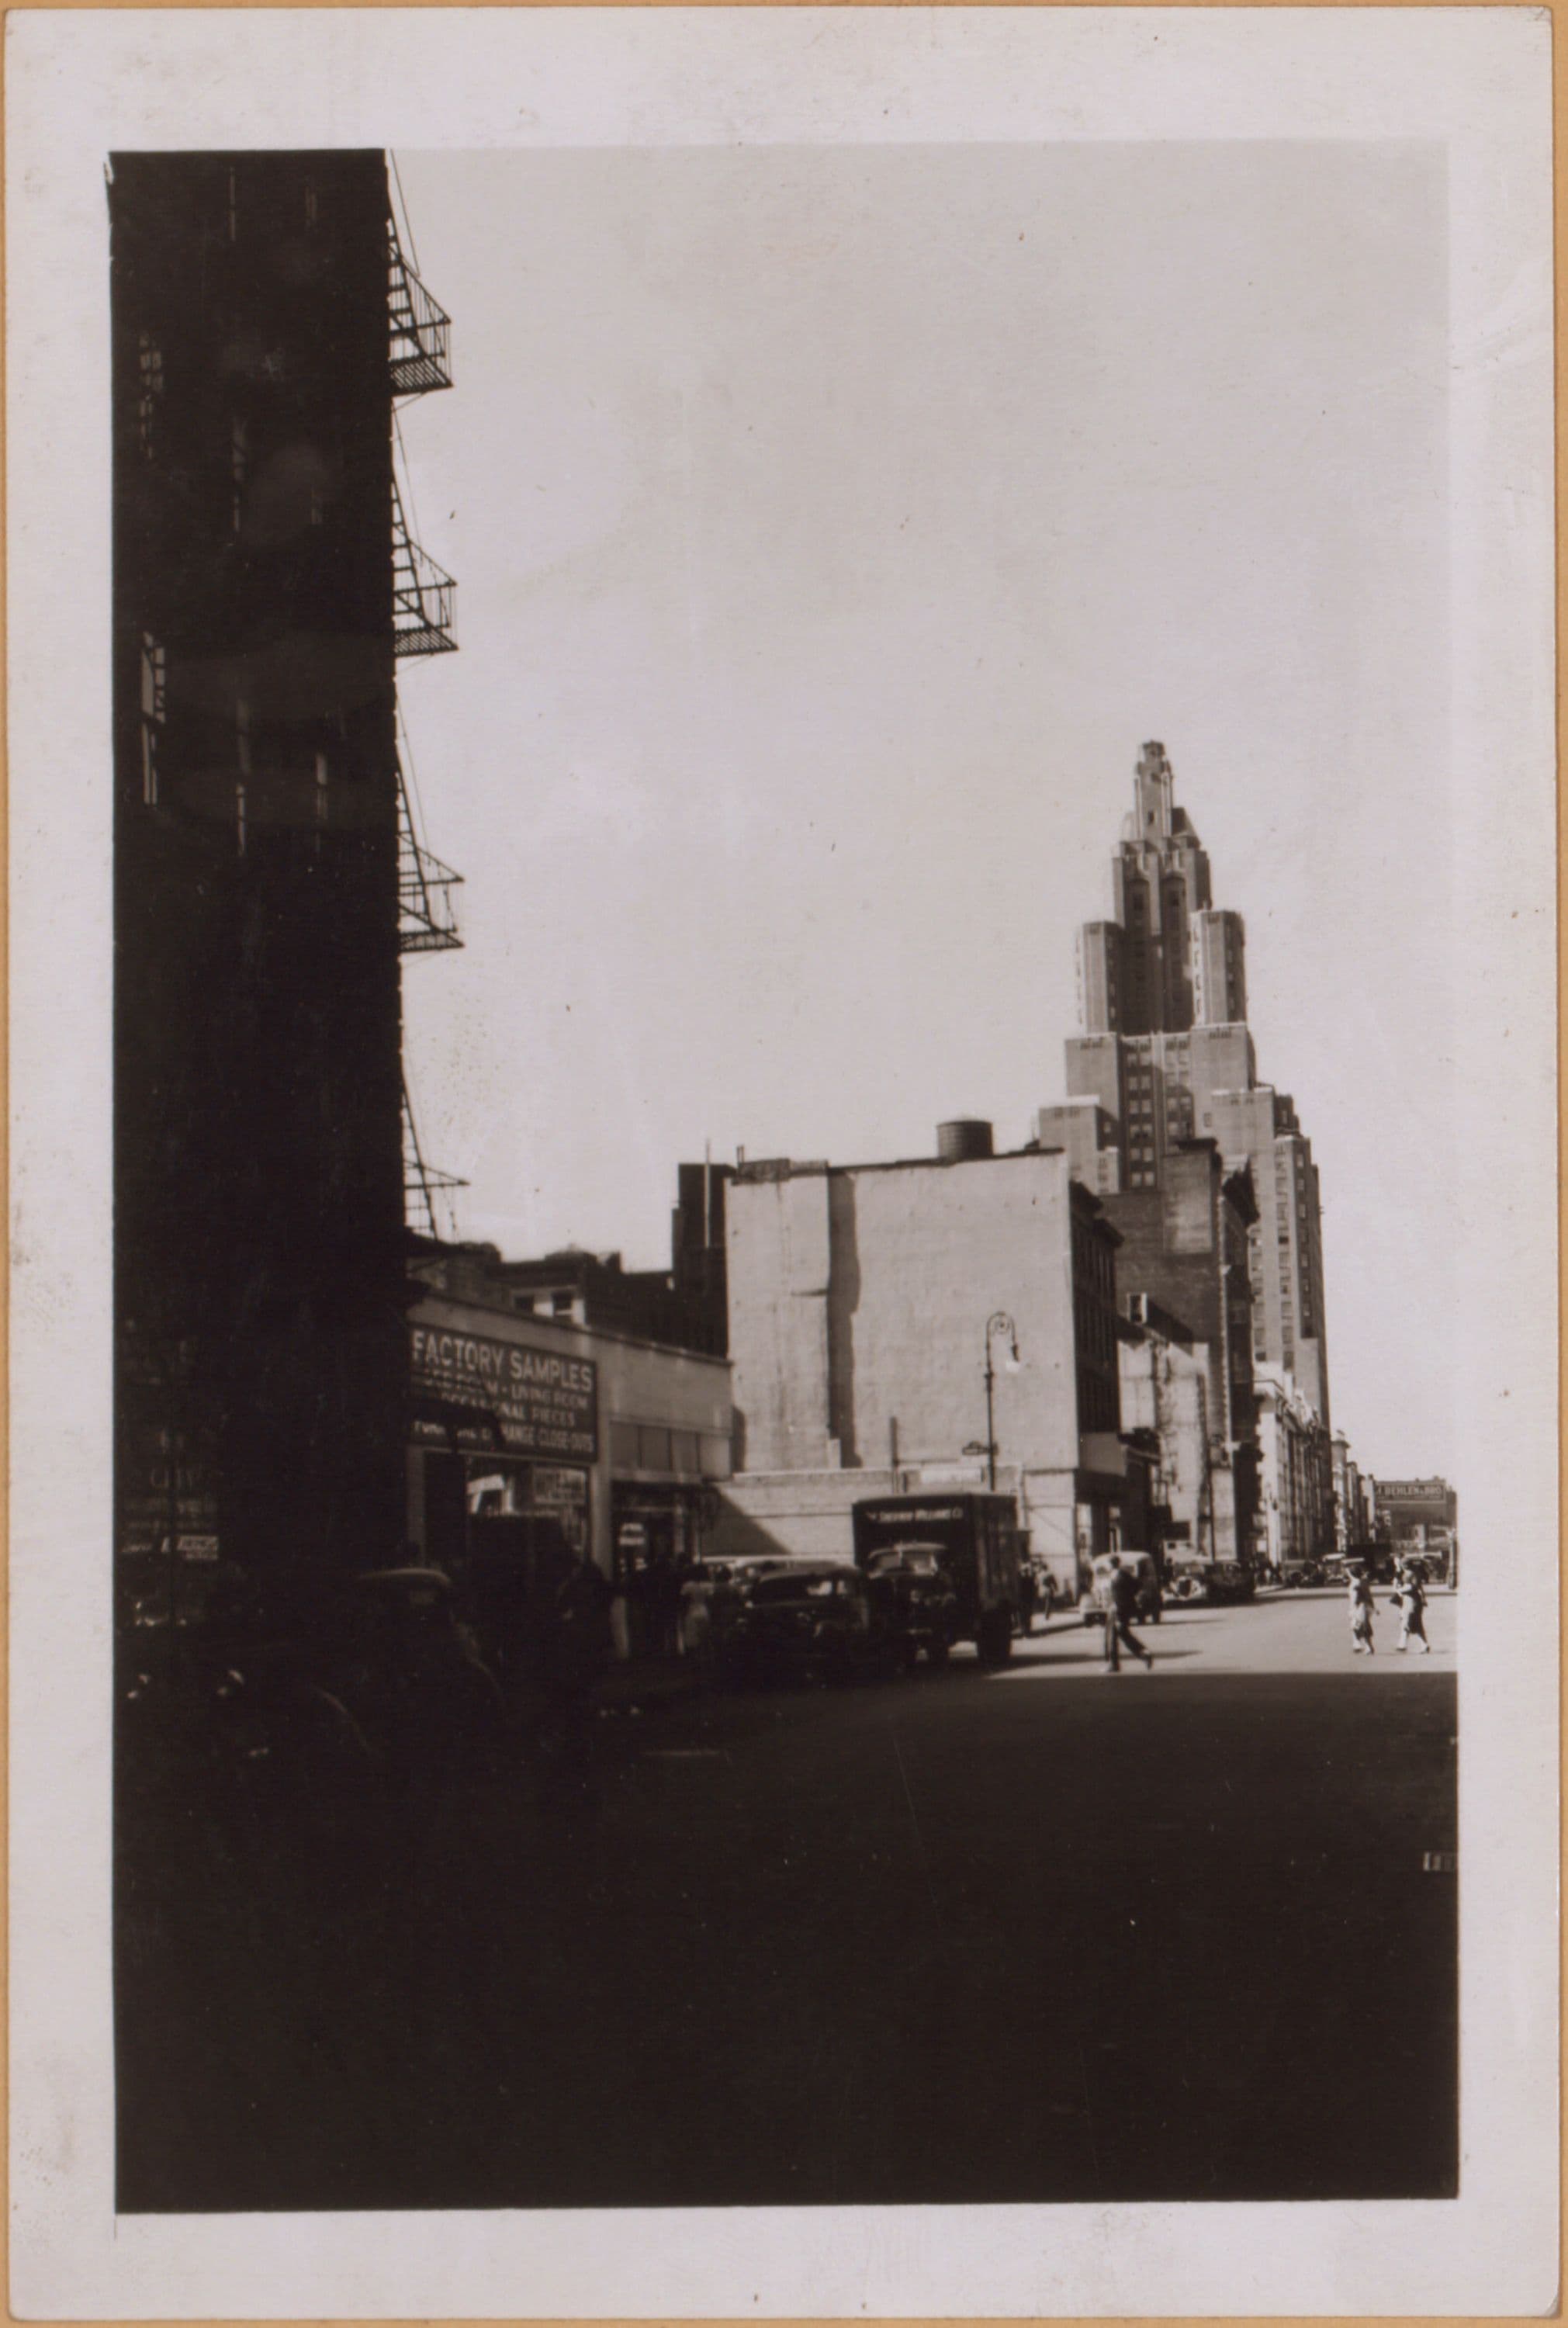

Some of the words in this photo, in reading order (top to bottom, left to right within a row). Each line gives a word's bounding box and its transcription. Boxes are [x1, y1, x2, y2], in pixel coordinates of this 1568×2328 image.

[412, 1329, 504, 1376] FACTORY
[509, 1349, 593, 1394] SAMPLES
[511, 1384, 551, 1407] LIVING
[553, 1393, 588, 1412] ROOM
[531, 1405, 575, 1428] PIECES
